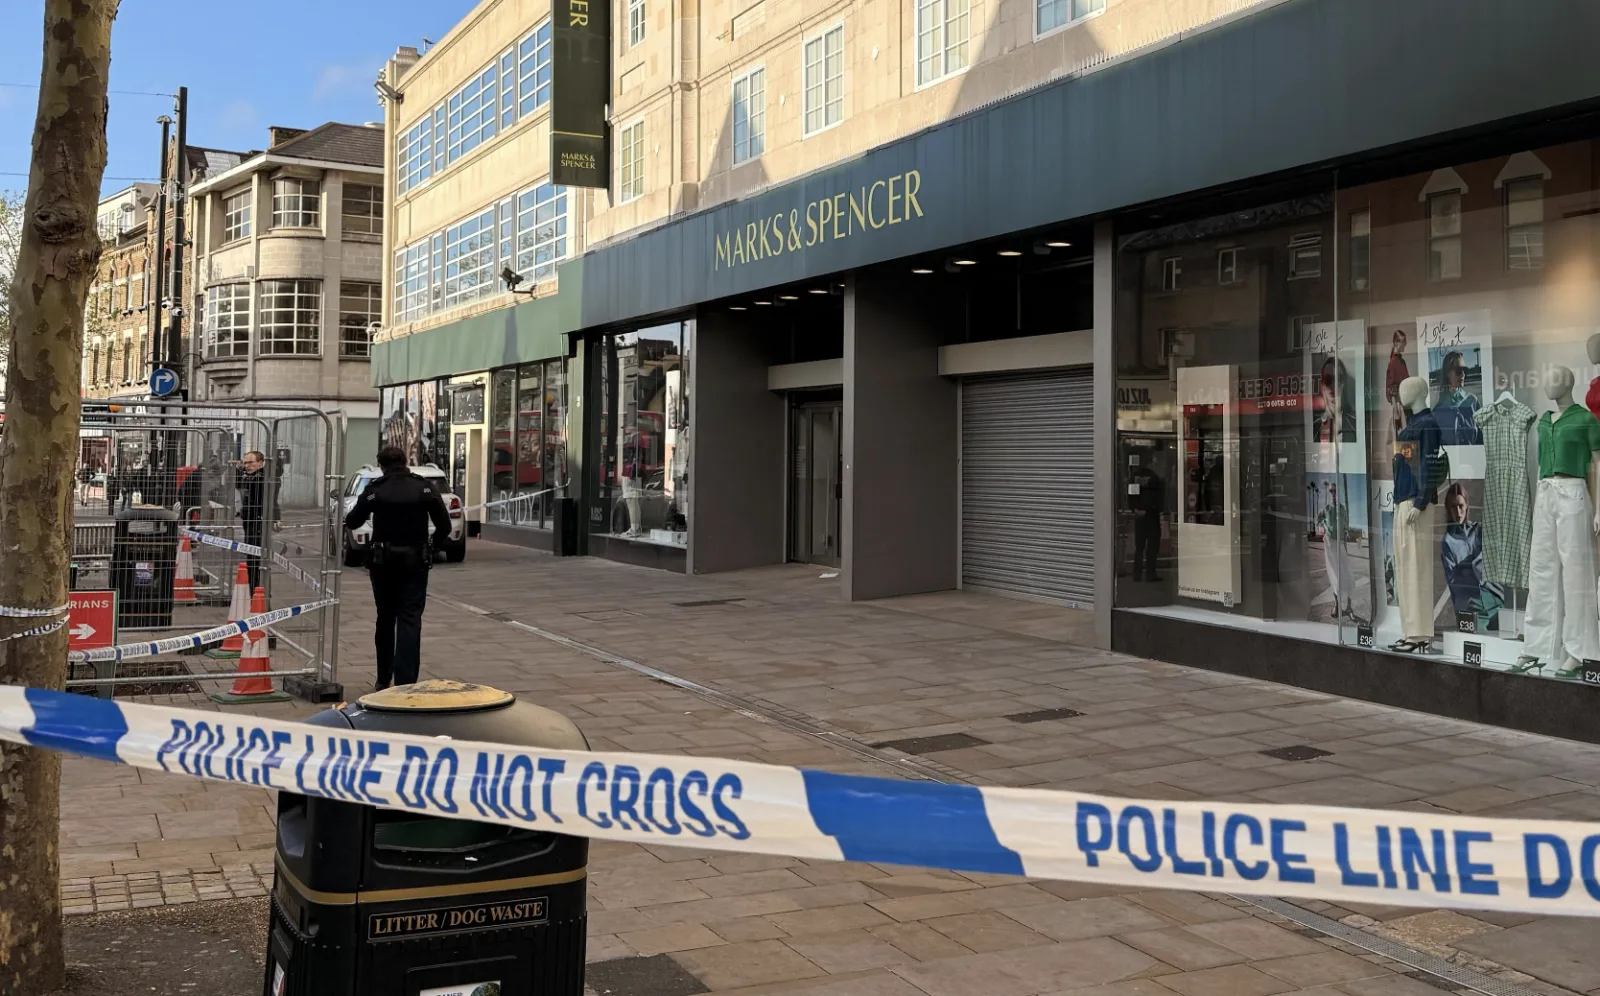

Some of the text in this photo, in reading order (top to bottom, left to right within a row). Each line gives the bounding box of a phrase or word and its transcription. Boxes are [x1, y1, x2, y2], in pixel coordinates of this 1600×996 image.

[561, 160, 596, 170] SPENCER
[715, 213, 784, 271] MARKS
[806, 170, 924, 247] SPENCER
[1459, 620, 1475, 632] £38
[1360, 635, 1374, 646] £38
[1465, 651, 1481, 664] £40
[156, 718, 752, 841] POLICE LINE DO NOT CROSS
[1075, 801, 1317, 885] POLICE
[1333, 821, 1500, 896] LINE
[375, 913, 439, 934] LITTER
[450, 907, 487, 926] DOG
[490, 901, 543, 921] WASTE
